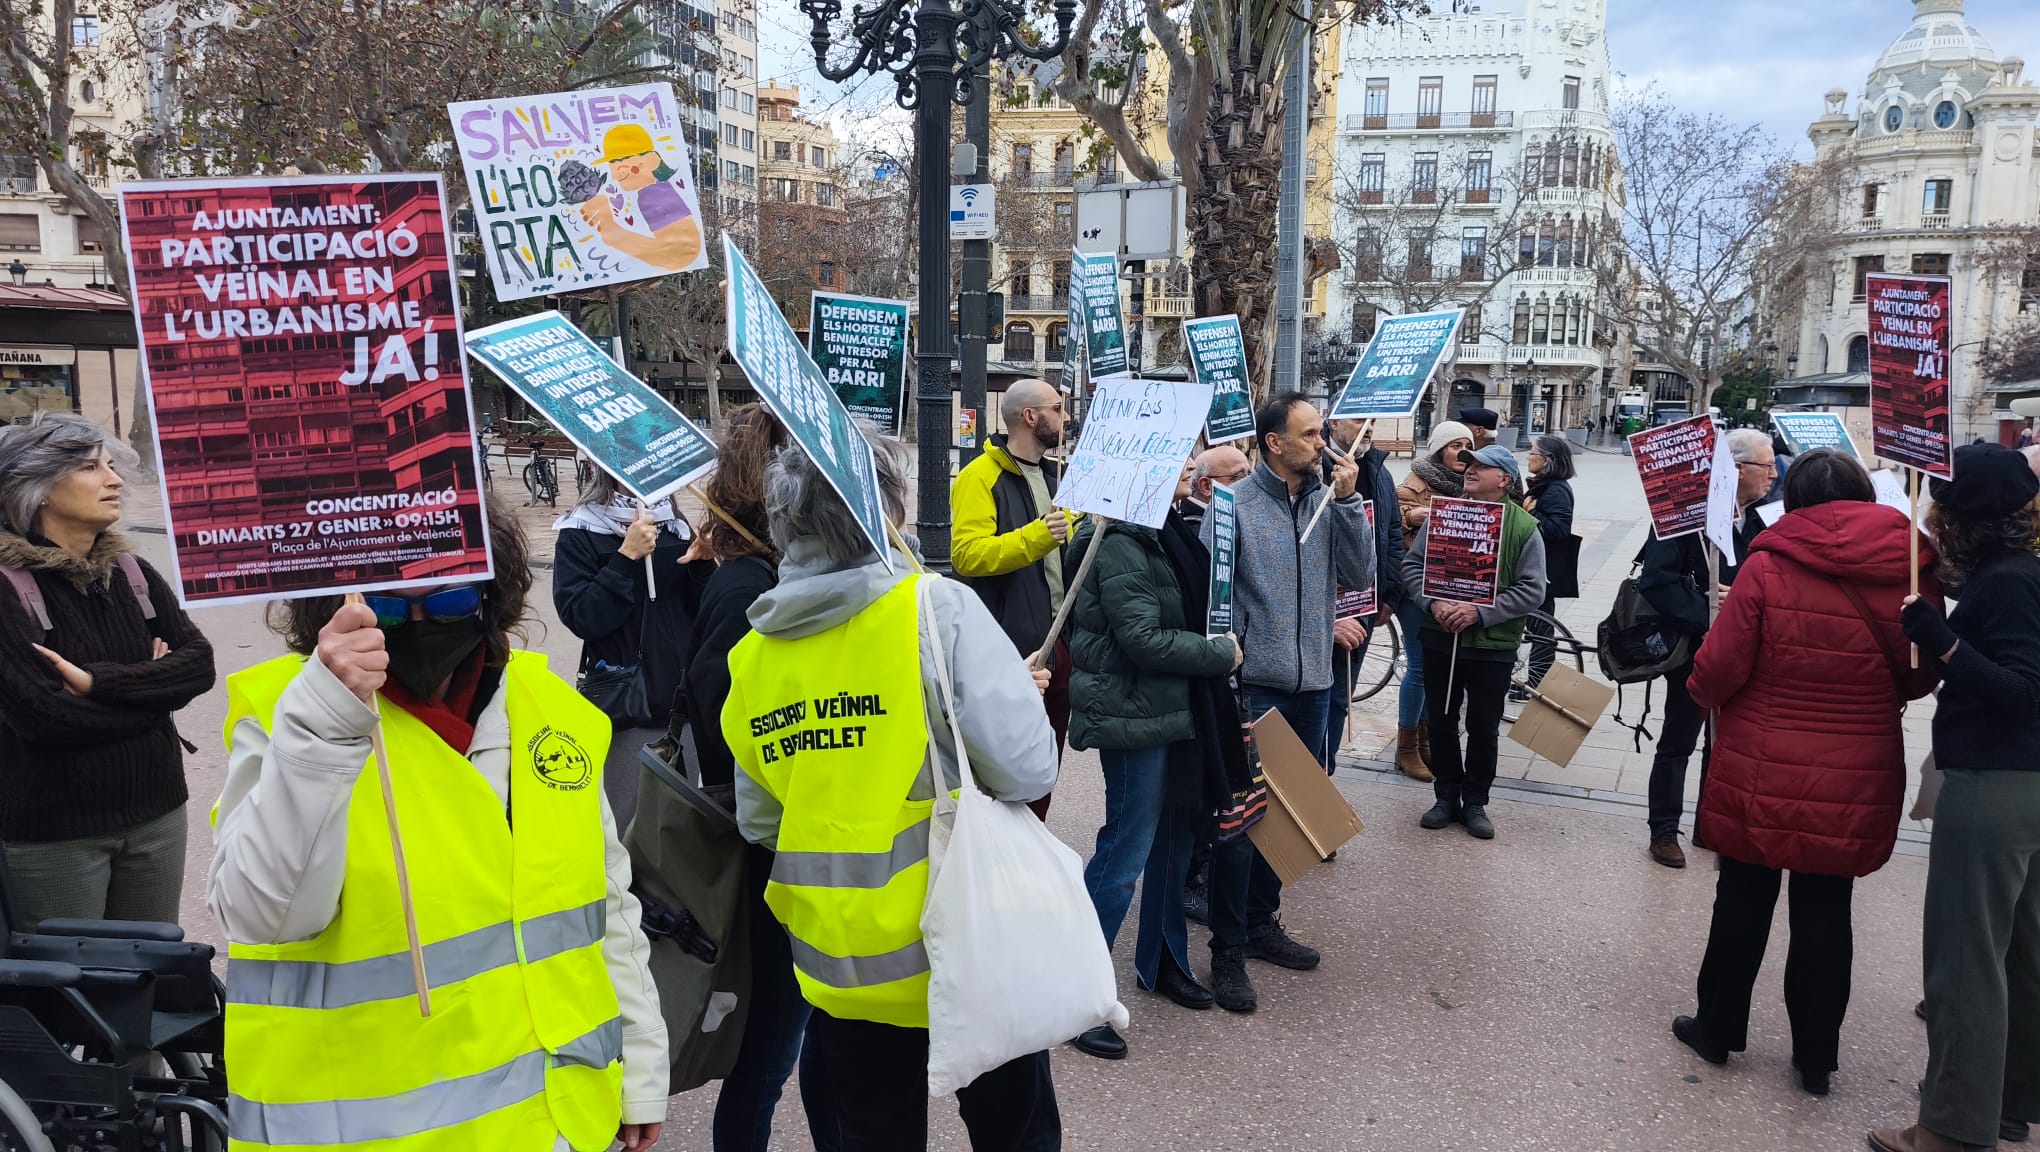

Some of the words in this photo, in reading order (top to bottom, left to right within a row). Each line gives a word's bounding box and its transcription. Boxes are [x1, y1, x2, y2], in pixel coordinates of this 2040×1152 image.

[460, 91, 666, 160] SALVEM
[475, 164, 558, 214] L'HO
[192, 204, 381, 231] AJUNTAMENT:
[160, 222, 419, 267] PARTICIPACIÓ
[490, 214, 583, 285] RTA
[195, 265, 336, 302] VEÏNAL
[345, 266, 394, 295] EN
[1881, 288, 1931, 301] AJUNTAMENT:
[821, 304, 898, 325] DEFENSEM
[1873, 300, 1941, 318] PARTICIPACIÓ
[165, 301, 434, 341] L'URBANISME,
[823, 320, 841, 331] ELS
[843, 322, 880, 335] HORTS
[882, 325, 896, 336] DE
[1093, 317, 1117, 334] BARRI
[1383, 318, 1450, 334] DEFENSEM
[1881, 315, 1915, 333] VEÏNAL
[1917, 320, 1932, 335] EN
[484, 325, 576, 361] DEFENSEM
[1192, 326, 1236, 342] DEFENSEM
[1397, 331, 1429, 340] HORTS
[1873, 331, 1942, 356] L'URBANISME,
[828, 344, 845, 355] UN
[847, 345, 888, 359] TRESOR
[1196, 342, 1208, 352] ELS
[1208, 340, 1229, 350] HORTS
[1229, 338, 1237, 347] DE
[1376, 349, 1391, 357] UN
[1392, 346, 1429, 356] TRESOR
[338, 333, 439, 387] JA!
[507, 357, 534, 374] ELS
[534, 347, 571, 368] HORTS
[568, 341, 588, 357] DE
[840, 356, 859, 367] PER
[861, 359, 875, 369] AL
[1204, 362, 1215, 371] UN
[1215, 359, 1237, 369] TRESOR
[1381, 356, 1399, 365] PER
[1400, 355, 1413, 363] AL
[1913, 353, 1943, 379] JA!
[828, 367, 885, 387] BARRI
[1213, 371, 1225, 380] PER
[1225, 370, 1233, 378] AL
[1366, 363, 1419, 378] BARRI
[545, 382, 568, 399] UN
[563, 368, 612, 393] TRESOR
[1144, 383, 1161, 397] ET
[1214, 379, 1241, 395] ARRI
[572, 393, 599, 409] PER
[595, 384, 616, 401] AL
[576, 393, 648, 433] BARRI
[847, 404, 893, 414] CONCENTRACIÓ
[1781, 418, 1837, 426] DEFENSEM
[1902, 424, 1943, 440] CONCENTRACIÓ
[1639, 428, 1707, 454] PARTICIPACIÓ
[1647, 425, 1697, 443] AJUNTAMENT:
[1649, 446, 1687, 460] VEÏNAL
[1688, 439, 1702, 450] EN
[305, 485, 457, 515] CONCENTRACIÓ
[1436, 510, 1496, 523] PARTICIPACIÓ
[198, 524, 286, 545] DIMARTS
[289, 521, 314, 538] 27
[318, 516, 382, 535] GENER
[395, 509, 460, 528] 09:15H
[1475, 523, 1488, 531] EN
[272, 542, 304, 554] Plaça
[307, 539, 321, 550] de
[324, 535, 394, 550] l'Ajuntament
[397, 532, 412, 541] de
[413, 528, 462, 540] València
[1468, 541, 1495, 554] JA!
[814, 692, 887, 719] VEÏNAL
[762, 741, 779, 764] DE
